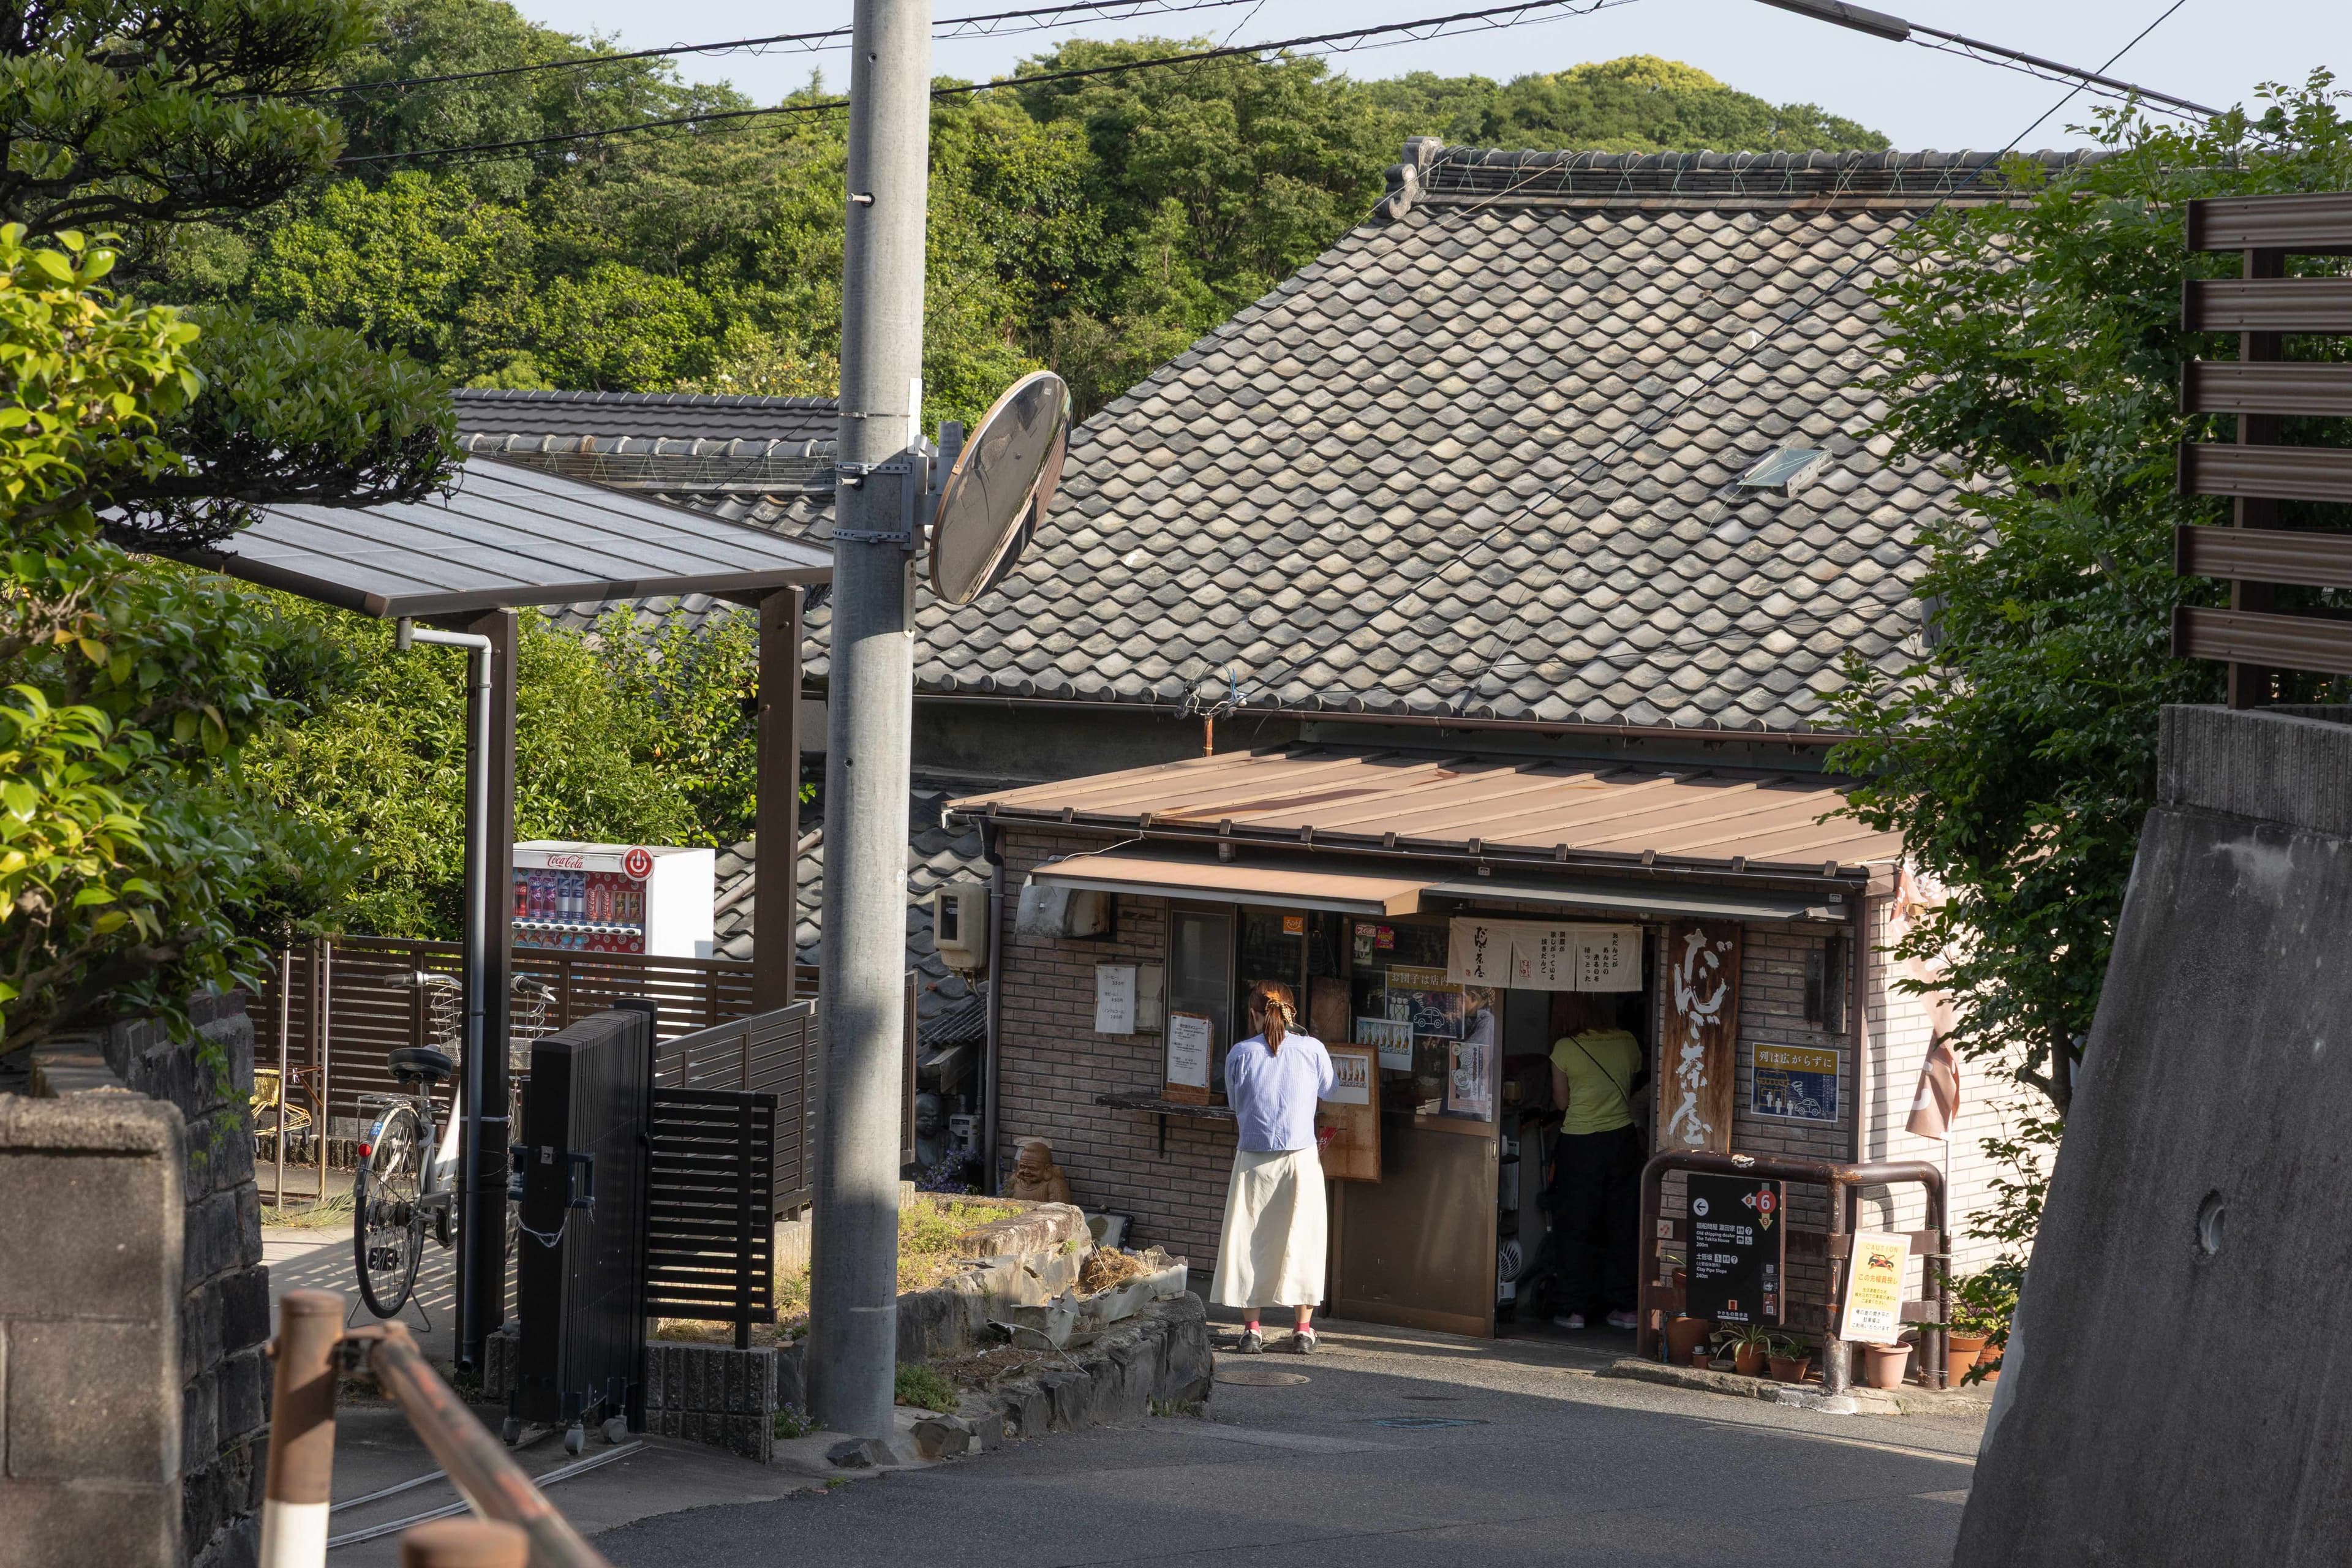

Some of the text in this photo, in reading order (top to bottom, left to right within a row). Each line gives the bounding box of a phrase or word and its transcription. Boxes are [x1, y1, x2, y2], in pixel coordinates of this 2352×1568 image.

[547, 854, 585, 869] Coca-Cola
[1474, 926, 1488, 978] だんご茶屋
[1667, 928, 1733, 1145] だんご茶屋
[1758, 1050, 1833, 1068] 列は広がらずに
[1760, 1194, 1770, 1210] 6
[1866, 1244, 1899, 1253] CAUTION
